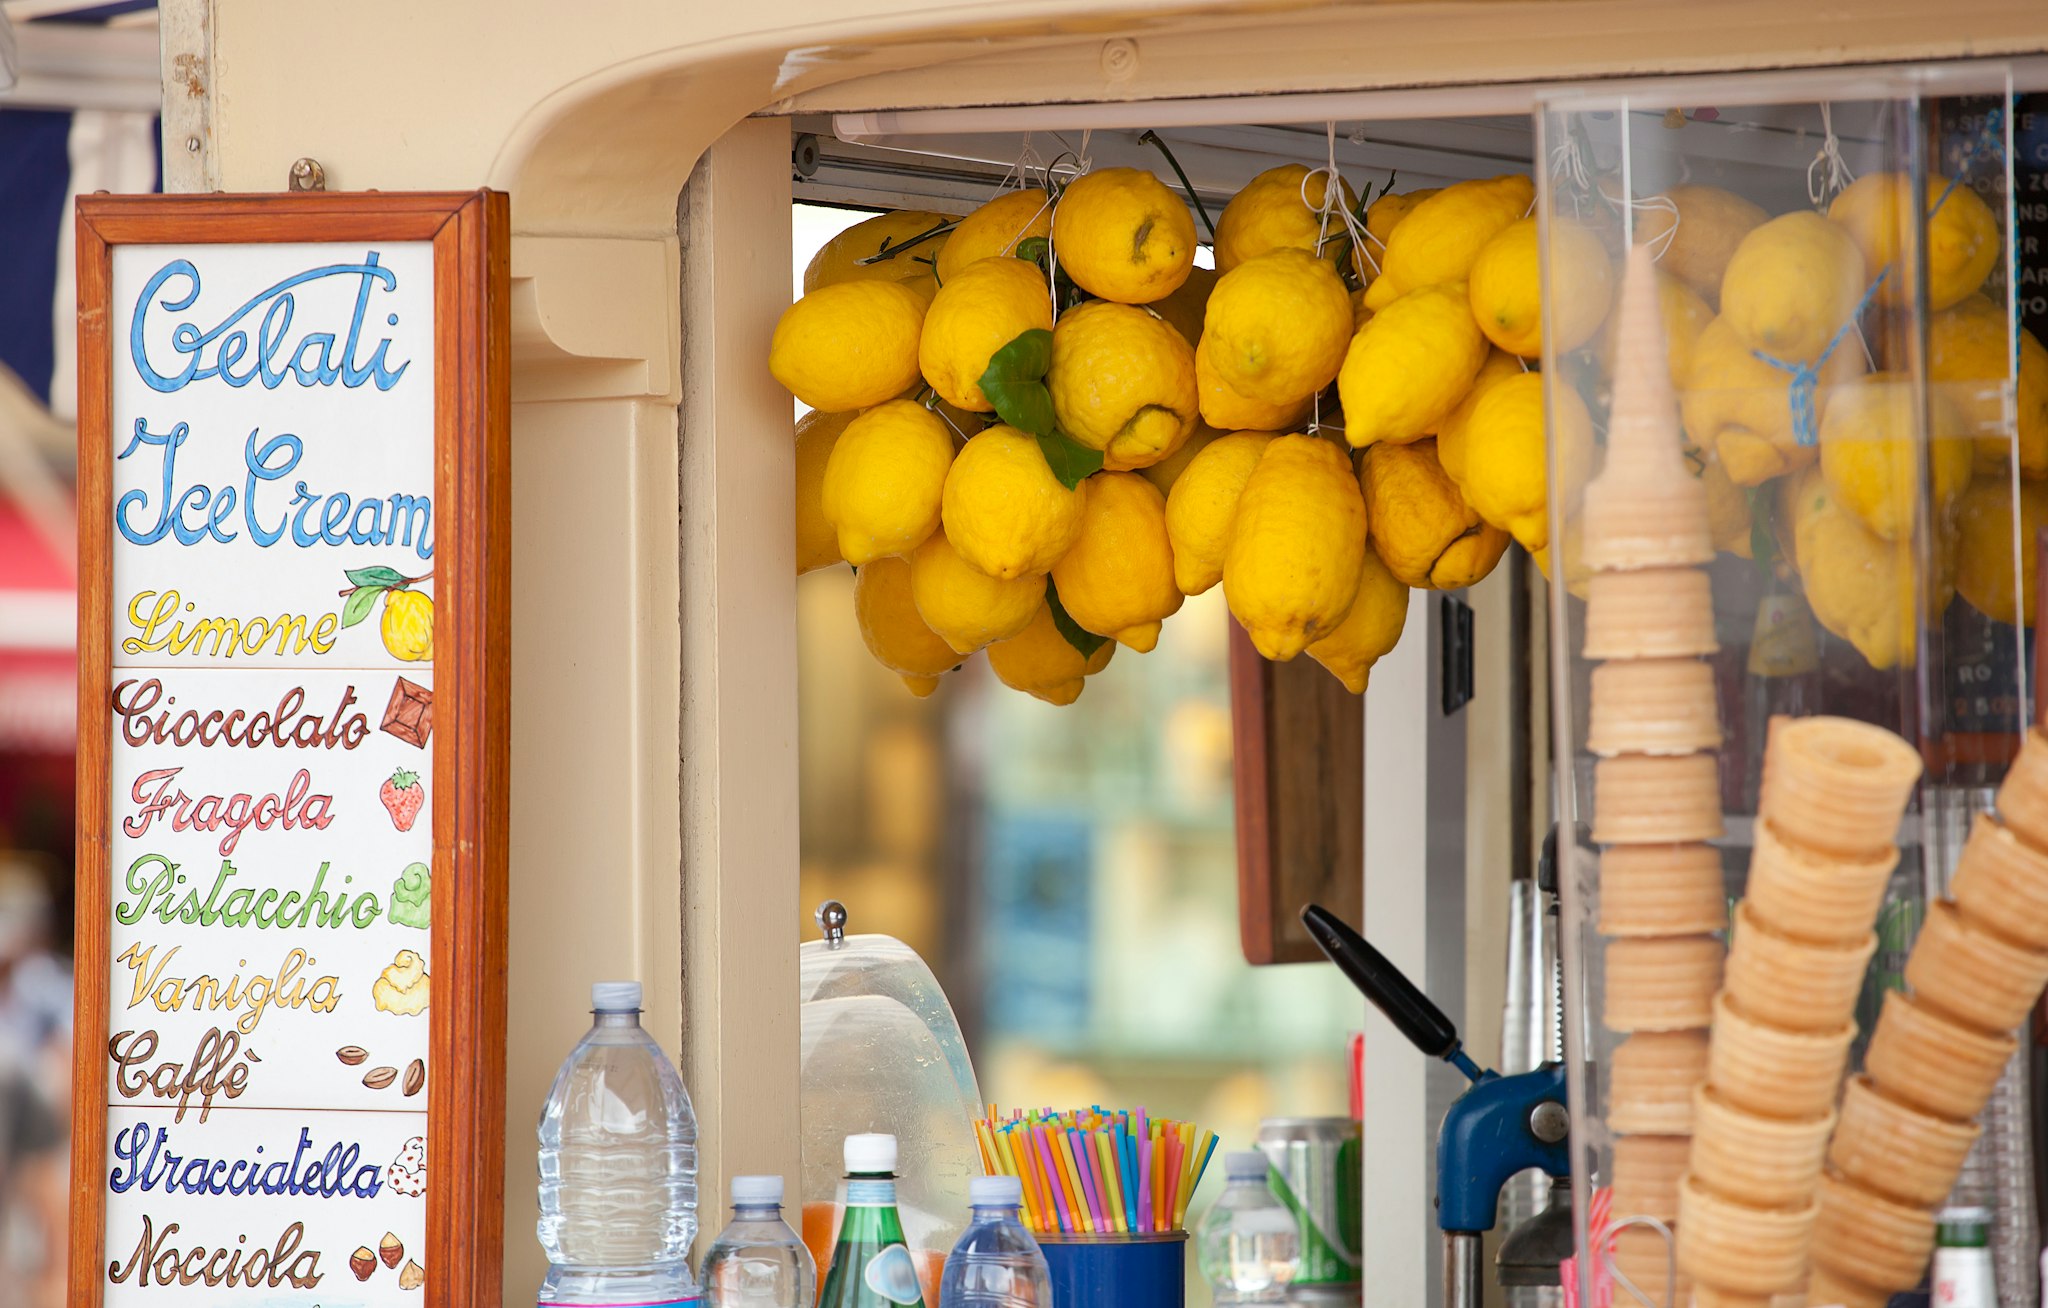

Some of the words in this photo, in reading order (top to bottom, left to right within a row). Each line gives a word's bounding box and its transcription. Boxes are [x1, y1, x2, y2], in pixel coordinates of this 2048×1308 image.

[131, 250, 411, 393] Gelati
[116, 417, 237, 546] Ice
[245, 427, 432, 559] Cream
[121, 589, 338, 659] Limone
[112, 678, 370, 750] Cioccolato
[122, 767, 335, 857] Fragola
[116, 853, 383, 929] Pistacchio
[116, 942, 342, 1036] Vaniglia
[109, 1026, 262, 1125] Caffè
[110, 1121, 384, 1199] Stracciatella
[108, 1215, 325, 1289] Nocciola
